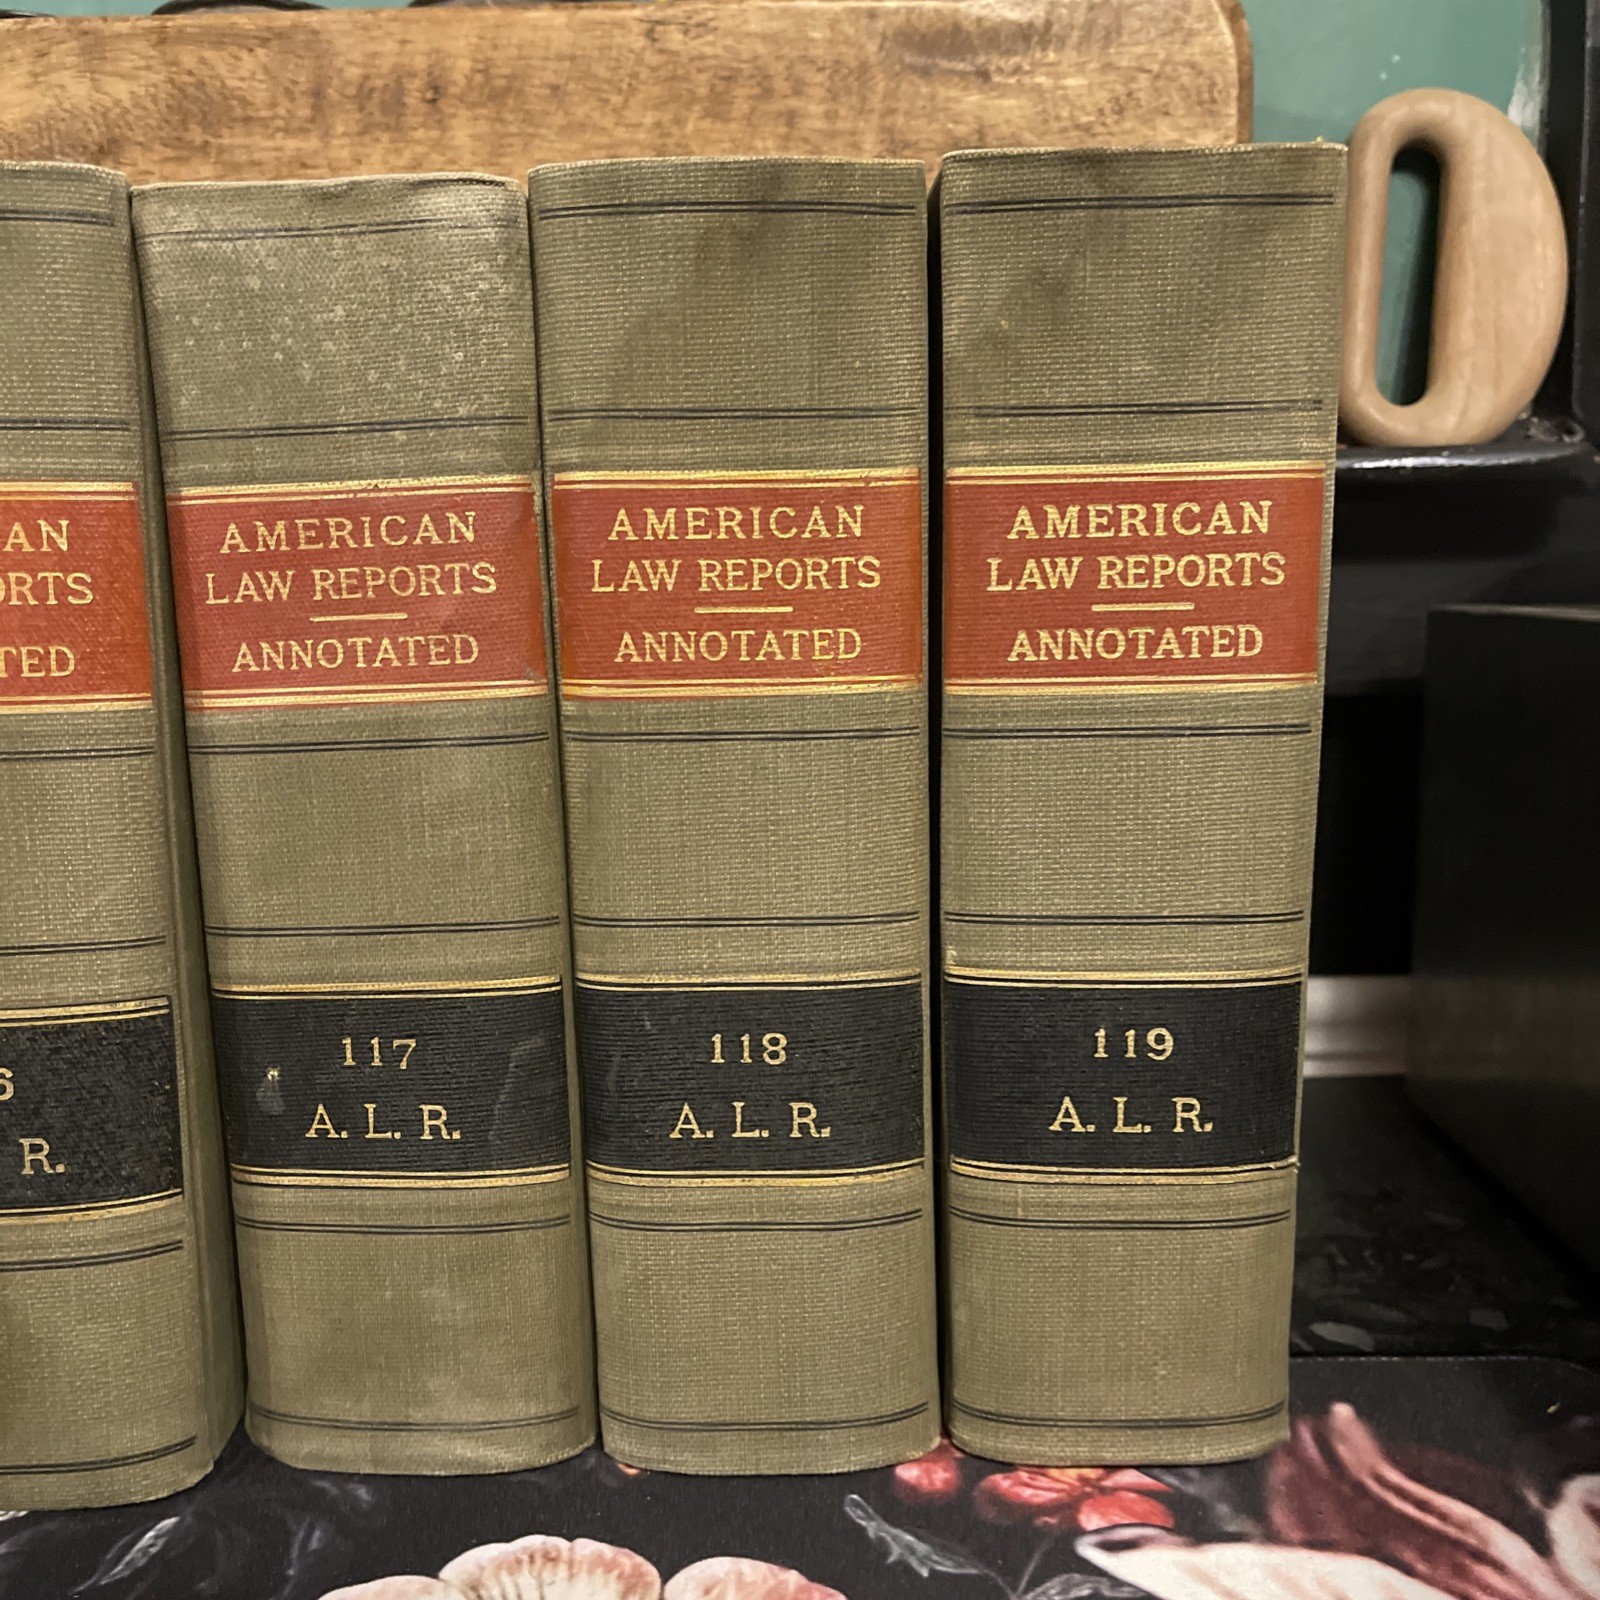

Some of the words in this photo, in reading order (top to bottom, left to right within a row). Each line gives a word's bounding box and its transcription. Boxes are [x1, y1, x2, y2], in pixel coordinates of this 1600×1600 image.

[219, 510, 477, 554] AMERICAN
[607, 504, 865, 541] AMERICAN
[1006, 500, 1273, 540] AMERICAN
[0, 571, 94, 606] RTS
[205, 569, 296, 606] LAW
[310, 561, 497, 601] REPORTS
[591, 558, 680, 593] LAW
[695, 555, 881, 592] REPORTS
[986, 556, 1083, 592] LAW
[1096, 551, 1286, 590] REPORTS
[231, 634, 479, 673] ANNOTATED
[613, 627, 862, 664] ANNOTATED
[1006, 623, 1264, 662] ANNOTATED
[341, 1036, 417, 1070] 117
[710, 1032, 788, 1065] 118
[1093, 1027, 1176, 1061] 119
[305, 1103, 349, 1140] A.
[363, 1103, 402, 1141] L.
[418, 1104, 463, 1140] R.
[669, 1102, 715, 1139] A.
[731, 1101, 770, 1138] L.
[788, 1101, 832, 1138] R.
[1048, 1096, 1096, 1133] A.
[1112, 1096, 1153, 1134] L.
[1171, 1096, 1213, 1134] R.
[18, 1137, 66, 1175] R.
